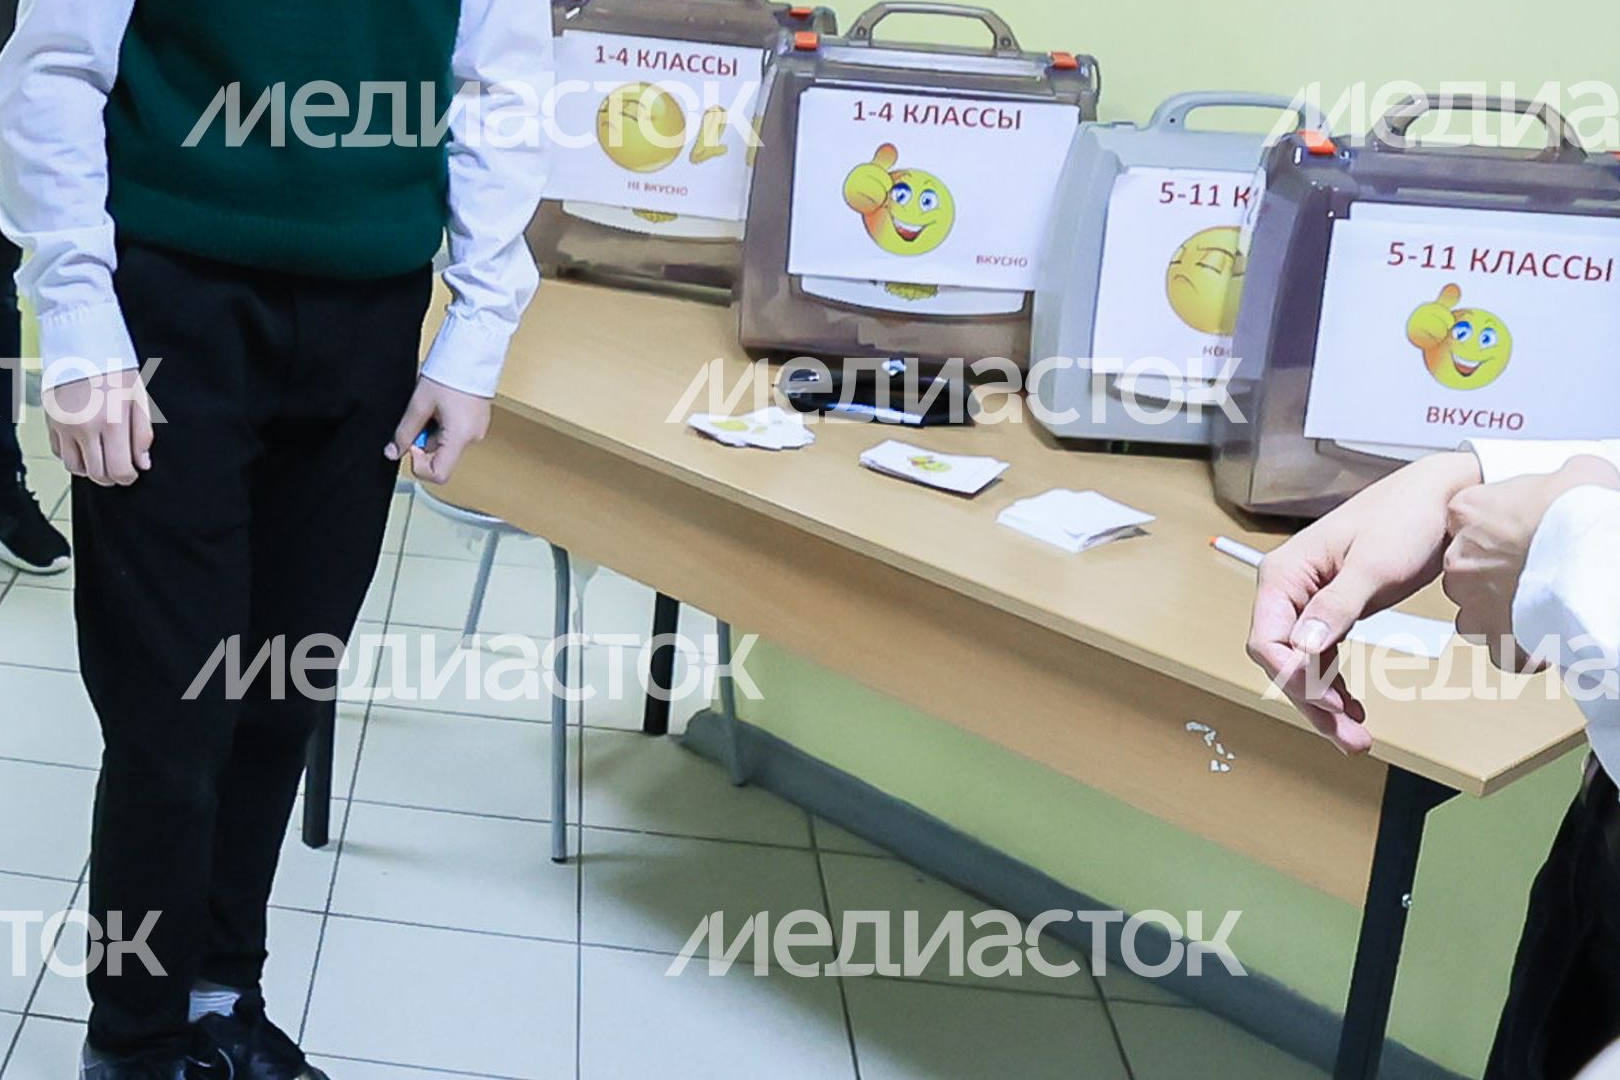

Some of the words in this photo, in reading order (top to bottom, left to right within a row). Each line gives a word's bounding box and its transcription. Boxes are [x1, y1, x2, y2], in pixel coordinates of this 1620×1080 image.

[595, 45, 629, 67] 1-4
[637, 49, 738, 77] КЛАССЫ
[852, 100, 893, 123] 1-4
[903, 104, 1022, 131] КЛАССЫ
[644, 183, 689, 197] ВКУСНО
[1159, 181, 1221, 208] 5-11
[976, 254, 1029, 269] ВКУСНО
[1387, 241, 1457, 271] 5-11
[1470, 248, 1615, 283] КЛАССЫ
[1426, 406, 1525, 432] ВКУСНО
